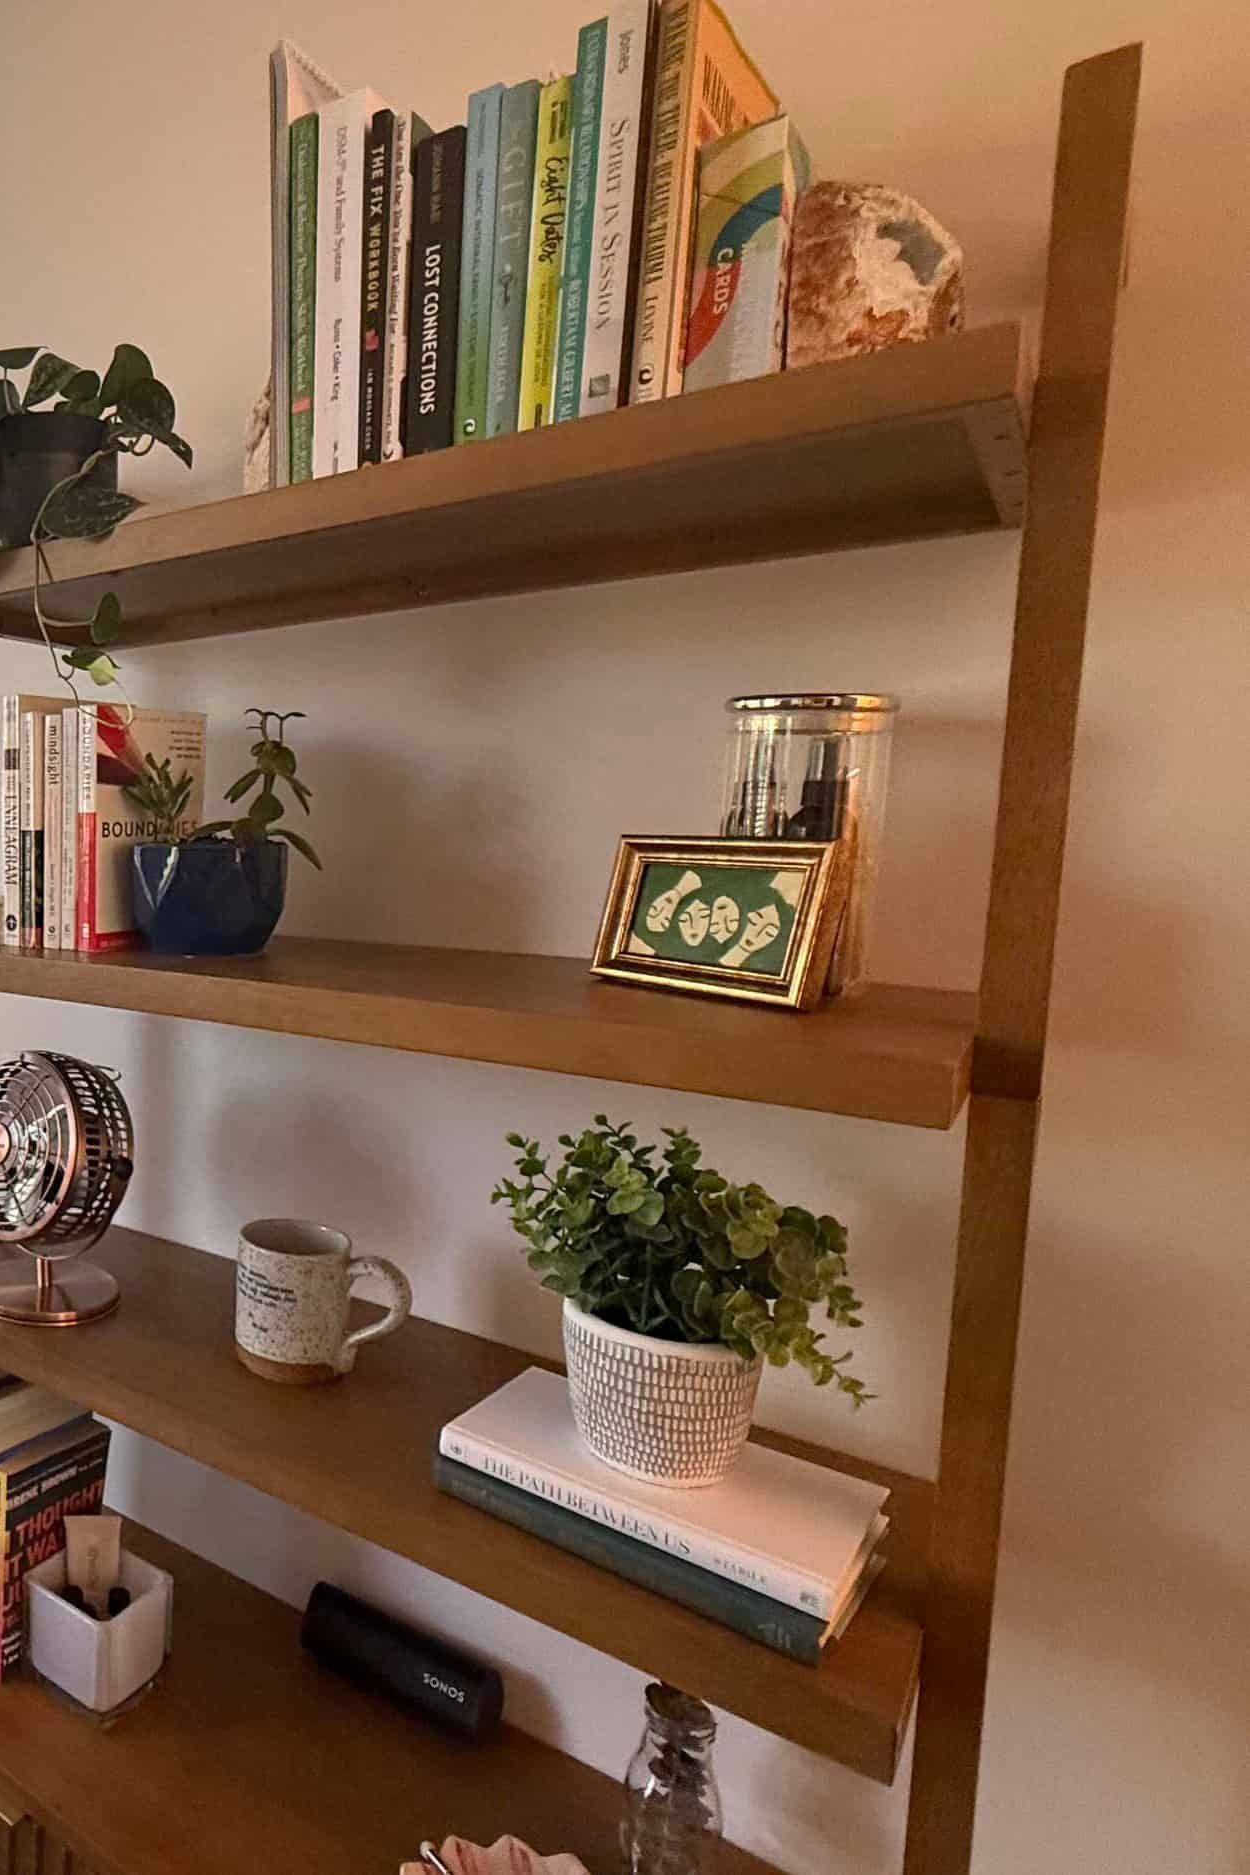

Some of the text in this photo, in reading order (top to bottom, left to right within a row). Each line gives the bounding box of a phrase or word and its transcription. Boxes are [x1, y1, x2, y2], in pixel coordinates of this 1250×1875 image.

[617, 29, 634, 74] Jones
[335, 174, 345, 194] and
[501, 147, 527, 247] GIFT
[540, 156, 569, 207] Eight
[333, 193, 347, 235] Family
[367, 144, 385, 312] THE FIX WORKBOOK
[538, 211, 566, 264] Dates
[333, 237, 345, 283] Systems
[713, 247, 734, 315] CARDS
[419, 243, 442, 415] LOST CONNECTIONS
[47, 725, 60, 785] mindsight
[4, 795, 18, 886] ENNEAGRAM
[15, 1478, 103, 1549] THOUGHT
[482, 1455, 515, 1481] THE
[519, 1471, 562, 1499] PATH
[567, 1492, 657, 1539] BETWEEN
[664, 1529, 692, 1554] US
[26, 1533, 59, 1565] WA
[423, 1672, 466, 1704] SONOS
